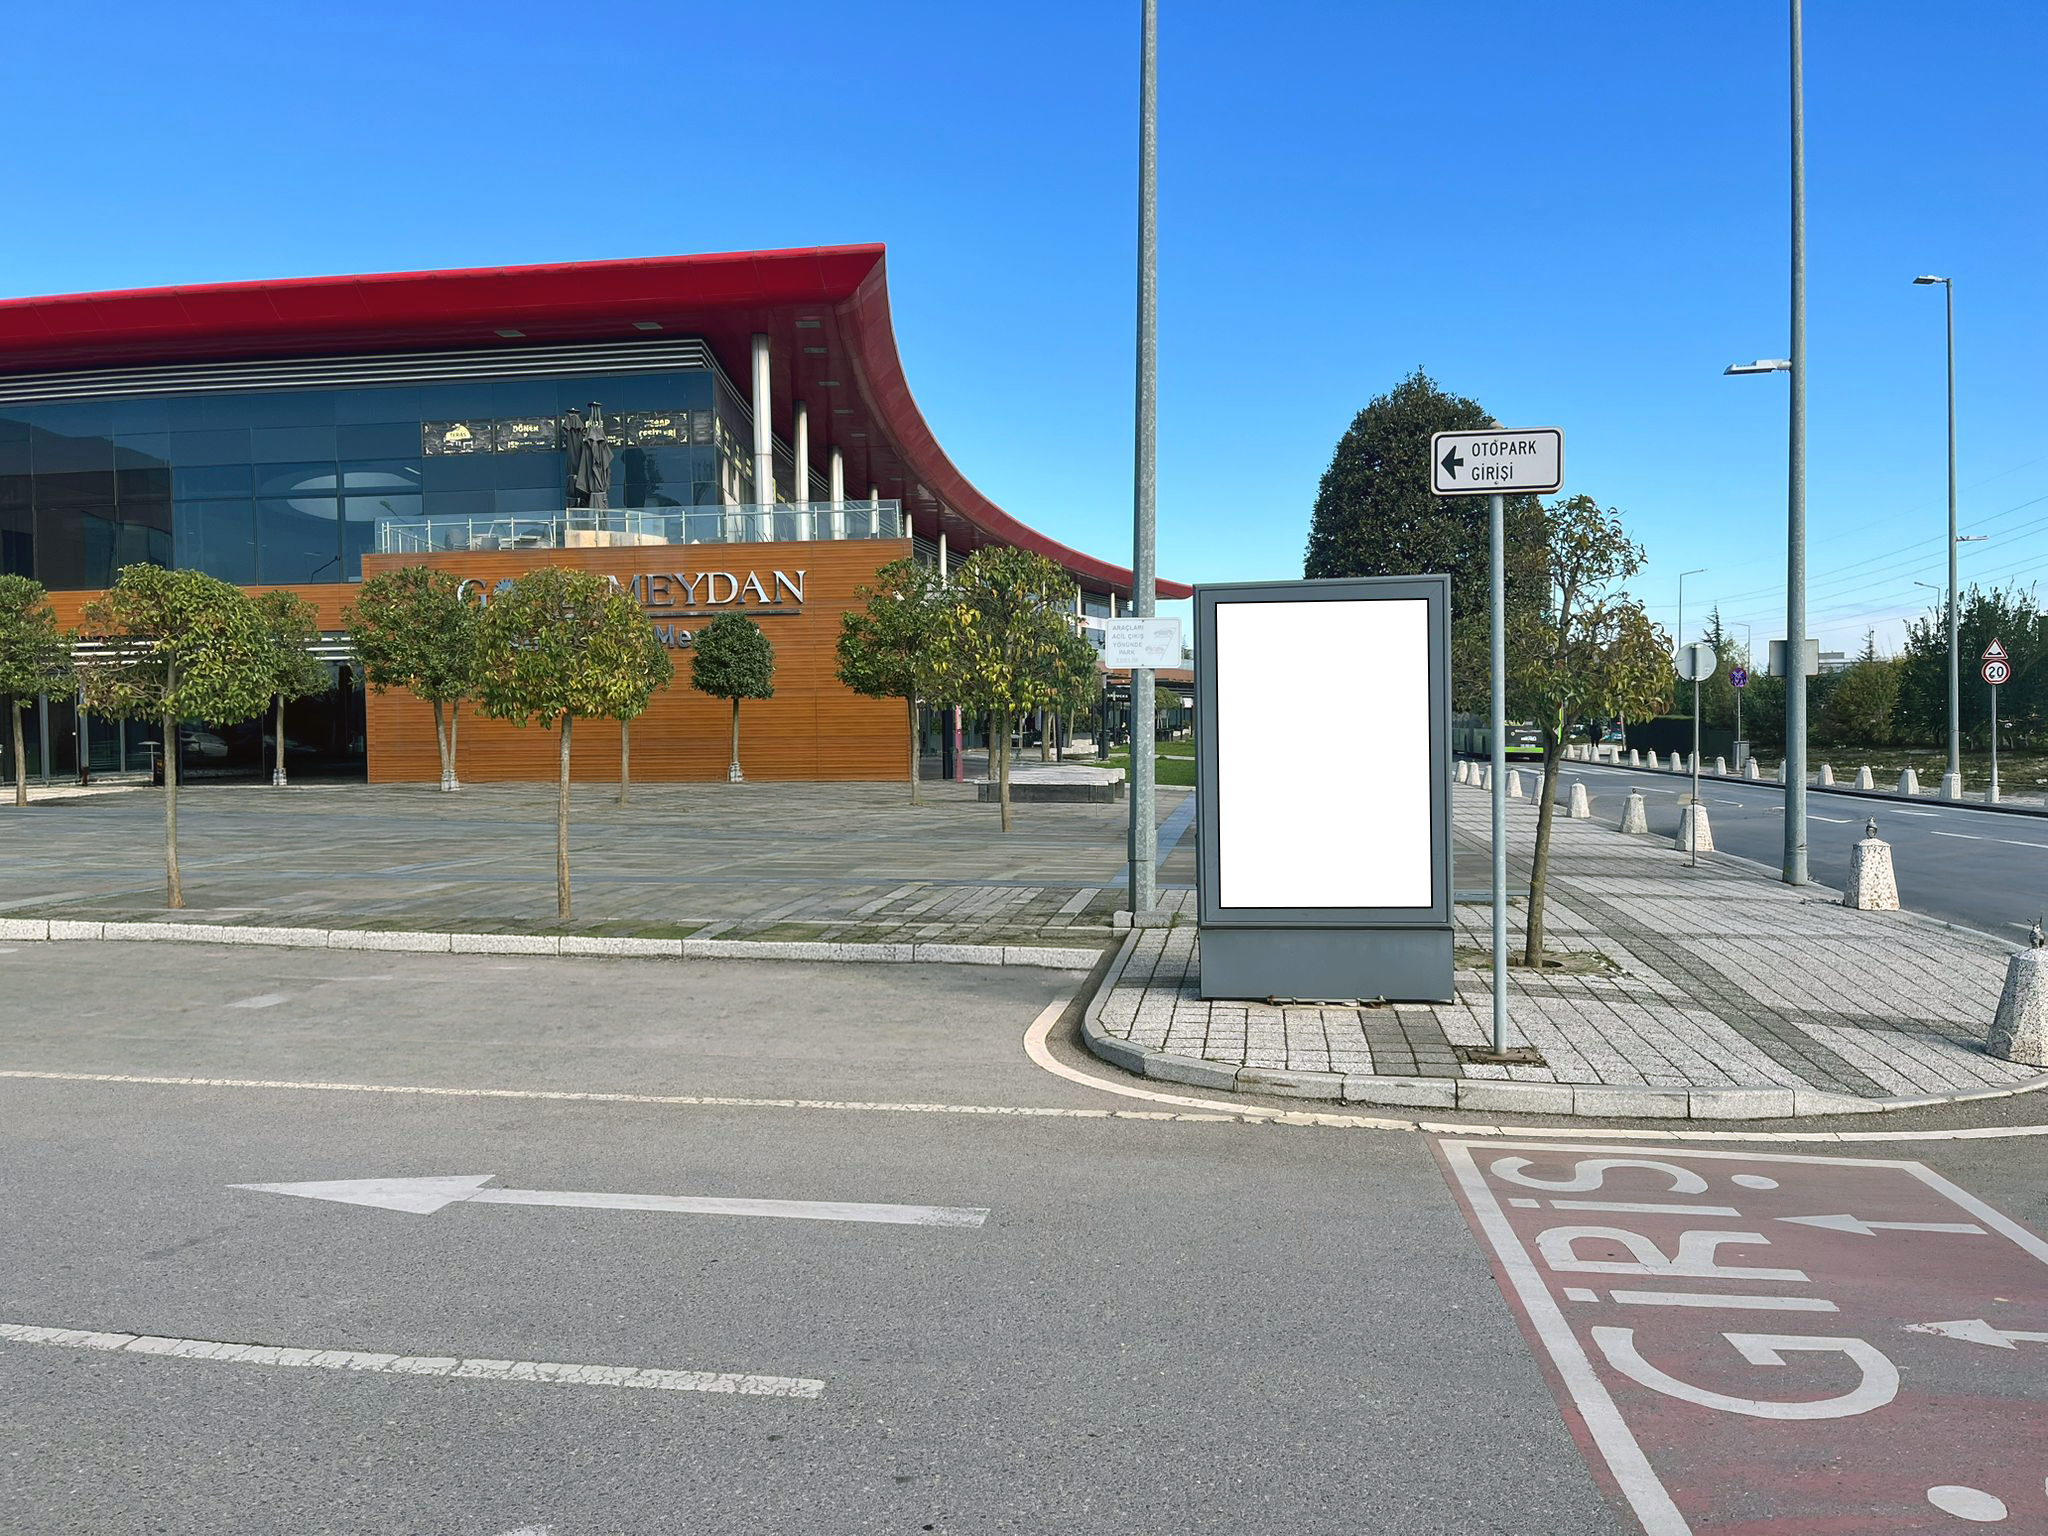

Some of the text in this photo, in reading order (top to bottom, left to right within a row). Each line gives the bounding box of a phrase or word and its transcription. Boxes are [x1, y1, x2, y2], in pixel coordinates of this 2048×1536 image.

[1471, 441, 1537, 457] OTOPARK
[1471, 461, 1513, 481] GİRİŞİ
[606, 570, 807, 606] MEYDAN
[1988, 666, 2004, 679] 20
